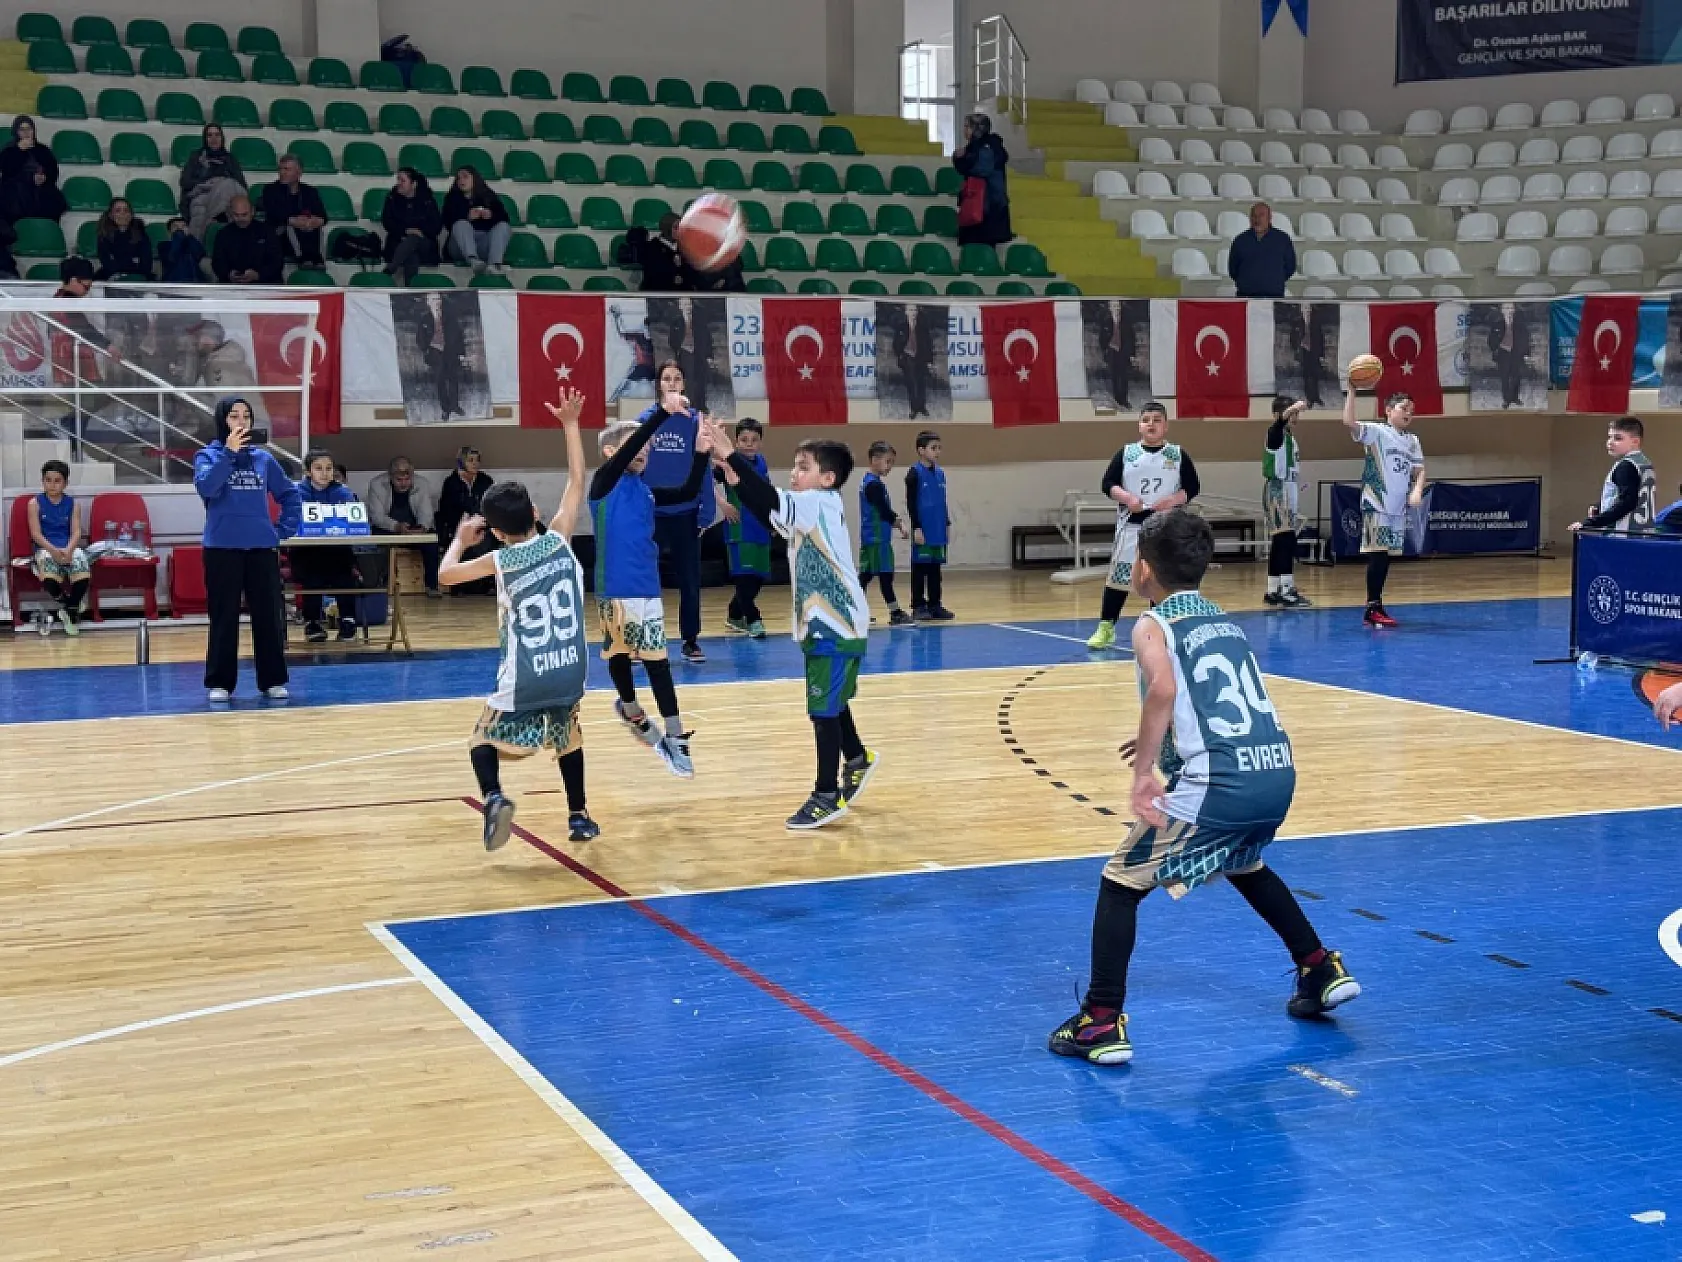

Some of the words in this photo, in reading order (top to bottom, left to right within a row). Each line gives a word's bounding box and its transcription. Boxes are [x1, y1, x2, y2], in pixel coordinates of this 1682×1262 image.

[1434, 2, 1528, 22] BAŞARILAR
[1564, 30, 1587, 41] BAK
[1524, 47, 1556, 60] SPOR
[1140, 477, 1163, 494] 27
[307, 506, 319, 521] 5
[351, 506, 361, 519] 0
[517, 578, 579, 649] 99
[1625, 603, 1646, 615] SPOR
[533, 646, 579, 677] ÇINAR
[1192, 653, 1284, 738] 34
[1236, 742, 1293, 772] EVREN
